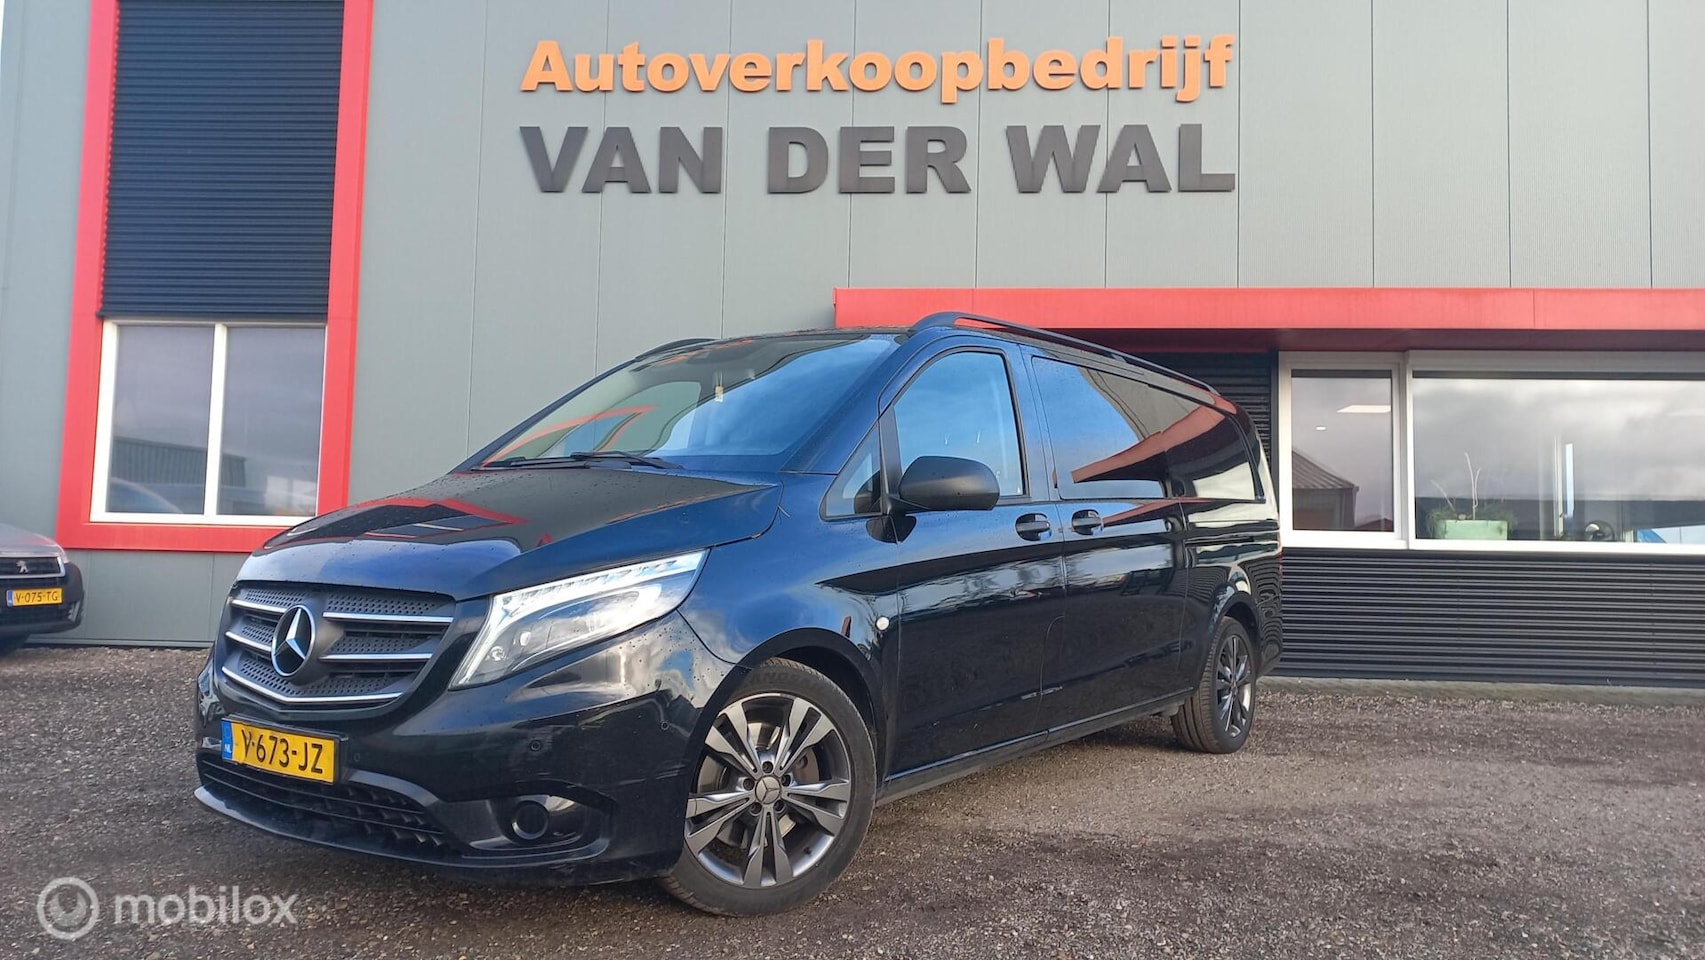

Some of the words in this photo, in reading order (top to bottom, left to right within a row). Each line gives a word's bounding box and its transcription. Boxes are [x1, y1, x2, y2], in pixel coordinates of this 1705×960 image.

[520, 34, 1235, 103] Autoverkoopbedrijf
[519, 126, 723, 193] VAN
[767, 126, 970, 193] DER
[1005, 123, 1236, 194] WAL
[15, 591, 58, 603] V-075-TG
[241, 728, 323, 774] V-673-JZ
